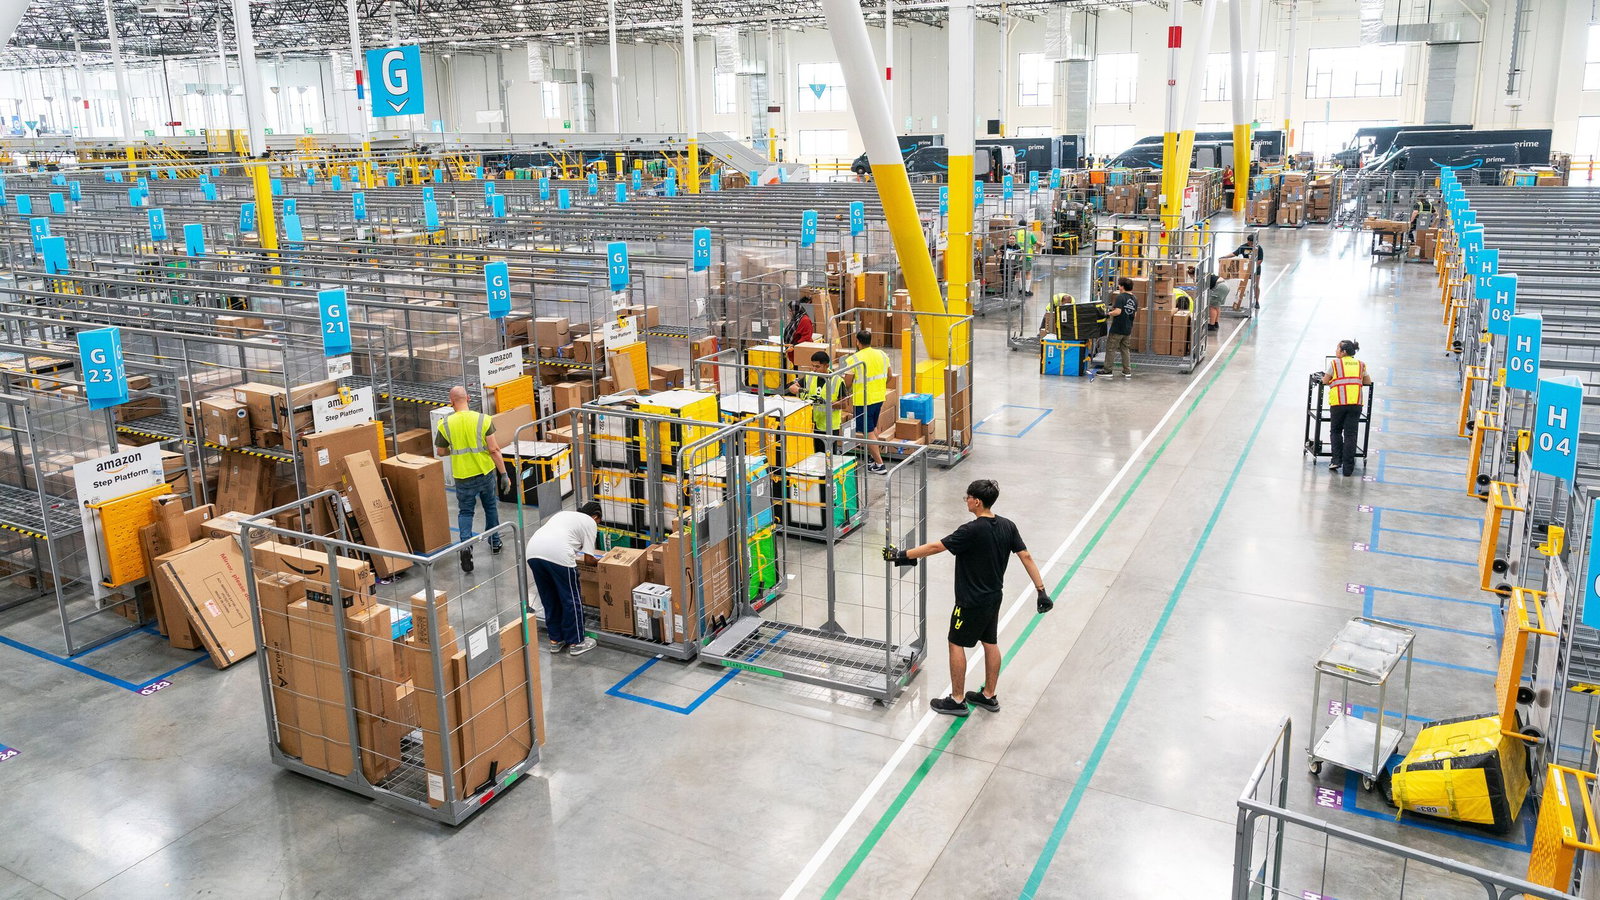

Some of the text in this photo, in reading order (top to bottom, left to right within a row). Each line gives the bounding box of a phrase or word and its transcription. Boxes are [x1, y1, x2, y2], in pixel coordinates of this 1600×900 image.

[382, 50, 409, 96] G
[854, 208, 860, 216] G
[806, 218, 813, 226] G
[36, 225, 42, 233] E
[699, 238, 706, 248] G
[1470, 243, 1478, 252] H
[613, 252, 623, 263] G
[697, 249, 708, 257] 15
[613, 265, 625, 274] 17
[1482, 262, 1492, 273] H
[493, 275, 503, 287] G
[492, 290, 507, 300] 19
[1496, 291, 1508, 305] H
[328, 304, 340, 318] G
[1492, 309, 1511, 321] 08
[327, 322, 344, 333] 21
[1517, 335, 1531, 353] H
[90, 348, 106, 364] G
[489, 352, 513, 364] amazon
[498, 364, 516, 372] Platform
[1510, 356, 1534, 373] 06
[88, 369, 114, 383] 23
[325, 407, 364, 422] Step Platform
[1547, 405, 1568, 429] H
[1539, 432, 1571, 456] 04
[96, 452, 142, 472] amazon
[93, 468, 149, 489] Step Platform
[219, 553, 234, 573] Mirror,
[231, 574, 246, 593] please
[1317, 787, 1336, 808] H-04
[1420, 806, 1438, 814] 683
